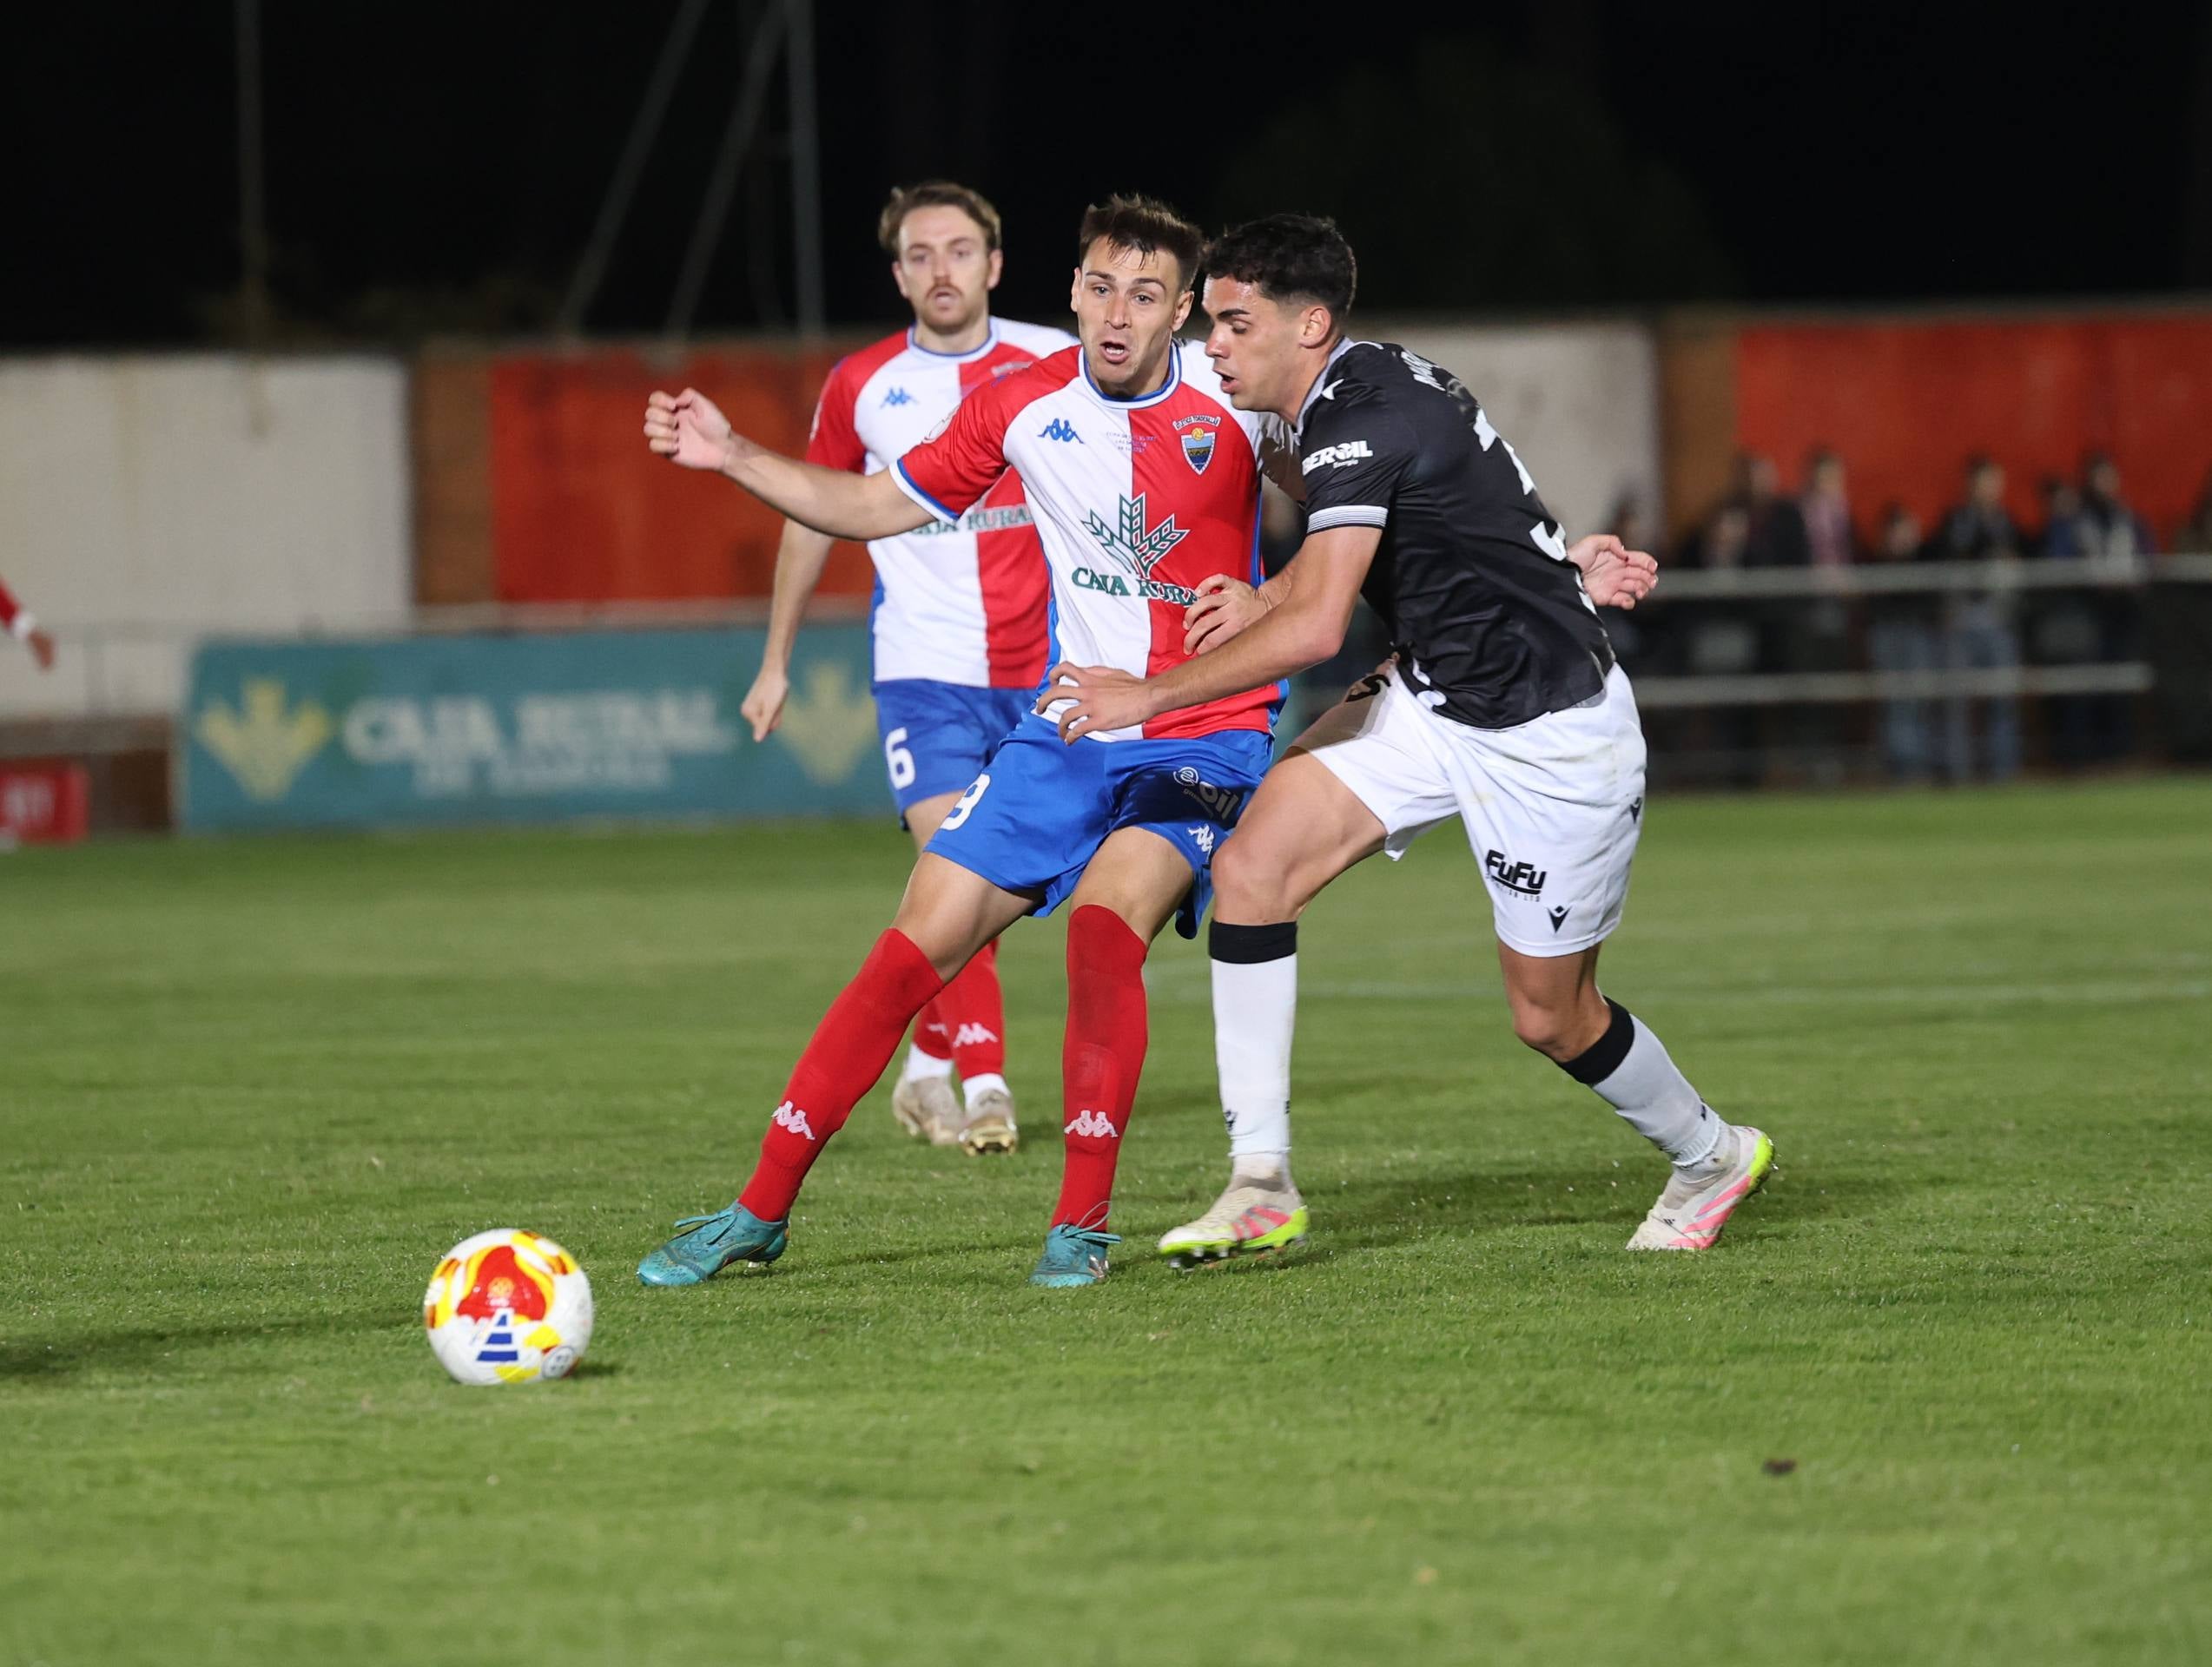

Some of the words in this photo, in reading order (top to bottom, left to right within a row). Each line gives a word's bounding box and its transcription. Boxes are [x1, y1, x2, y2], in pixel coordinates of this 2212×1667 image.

[967, 507, 1033, 530] RURA
[1136, 578, 1198, 606] RURA
[885, 728, 915, 790] 6
